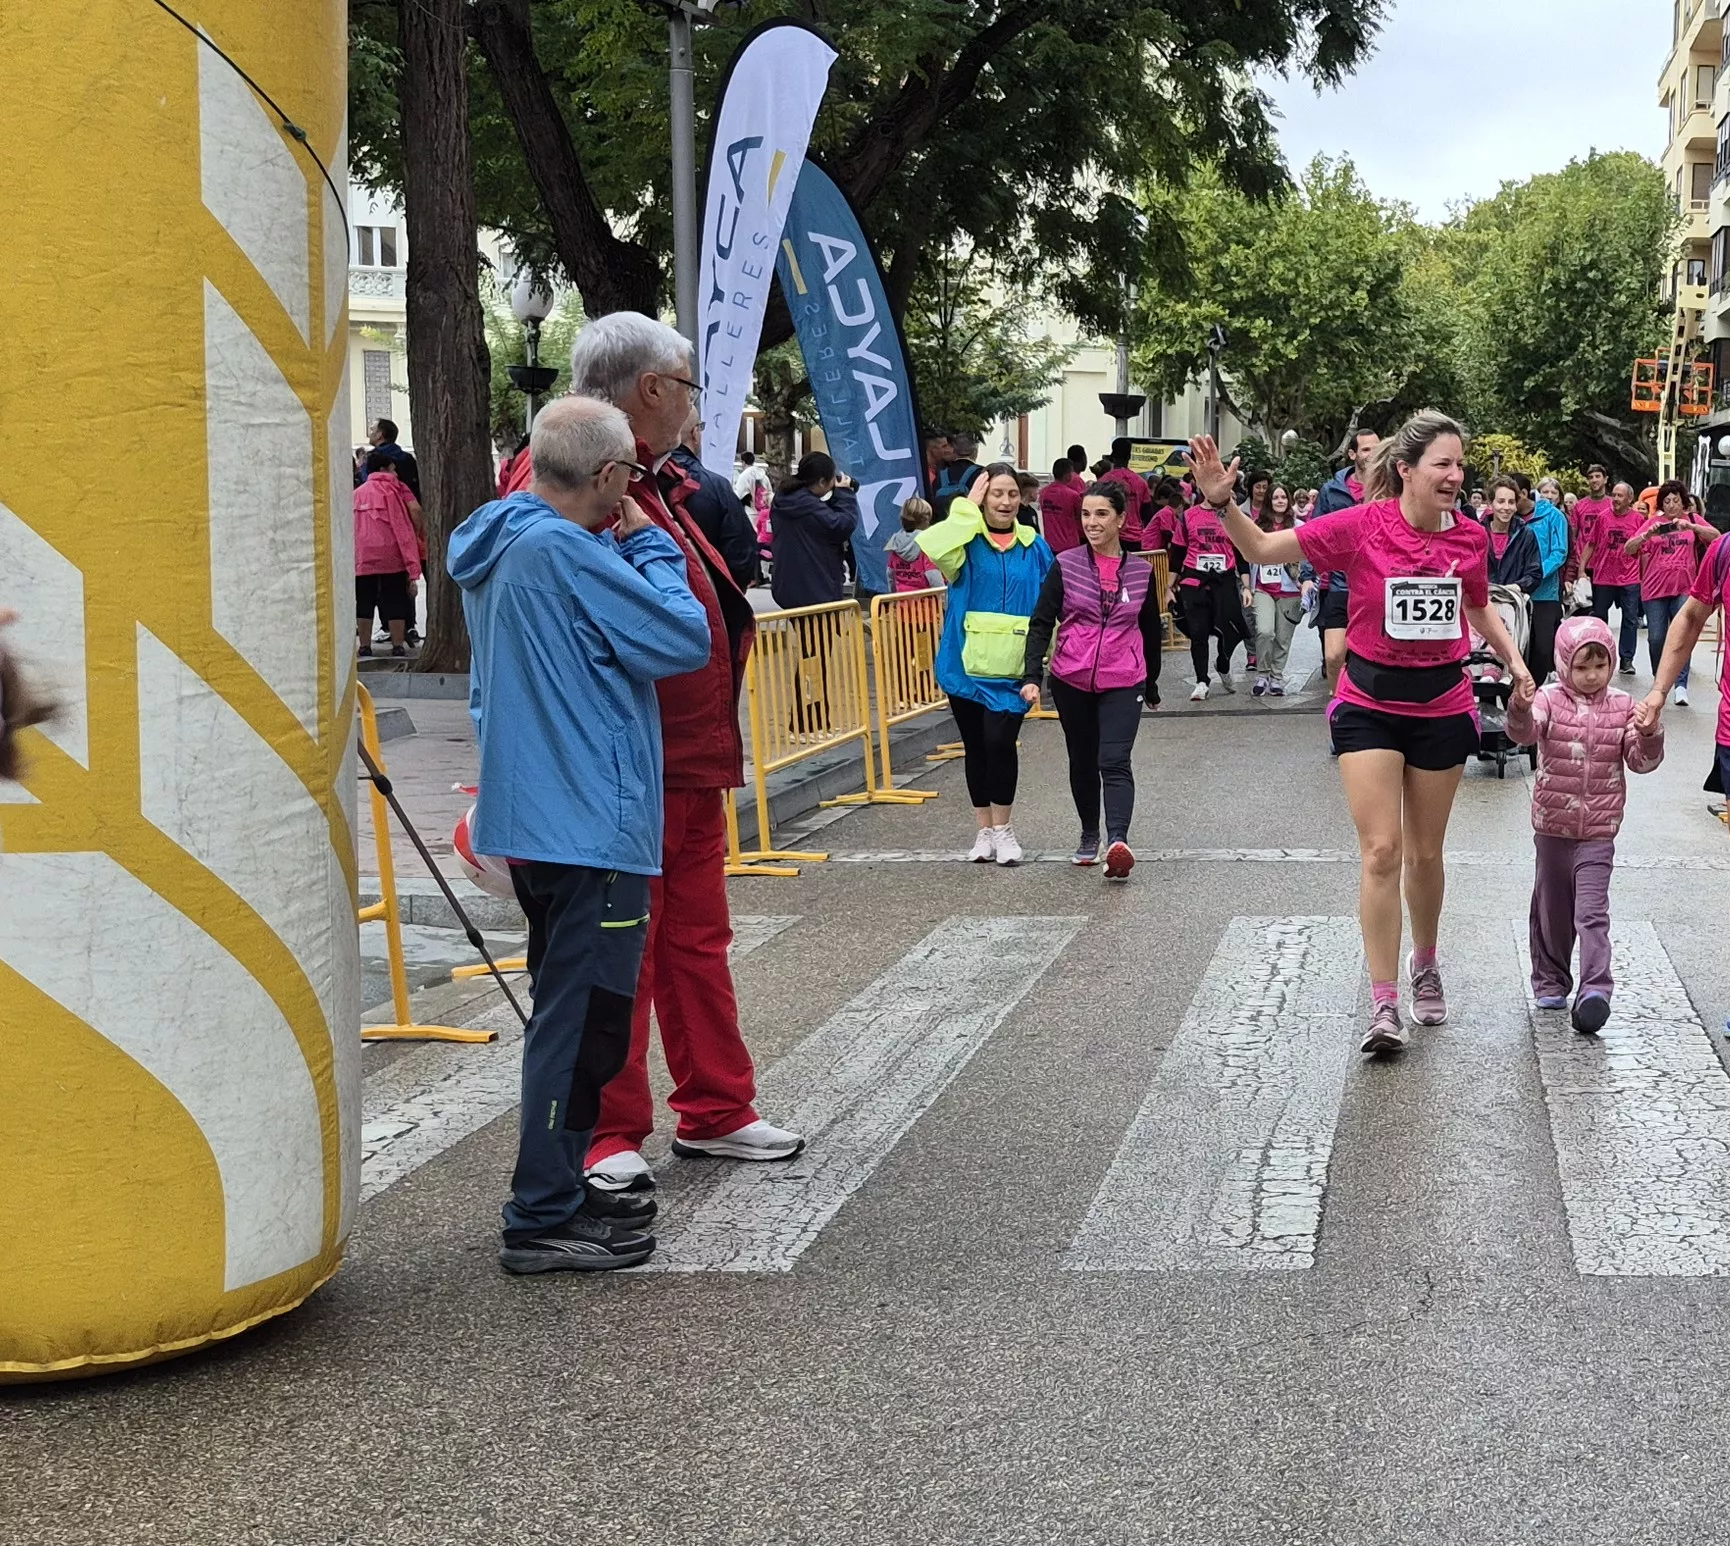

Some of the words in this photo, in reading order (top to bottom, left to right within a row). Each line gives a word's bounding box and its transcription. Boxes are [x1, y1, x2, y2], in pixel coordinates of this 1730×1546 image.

[704, 136, 764, 404] AYCA
[708, 231, 769, 450] TALLERES
[1203, 562, 1222, 571] 422
[1396, 599, 1455, 621] 1528
